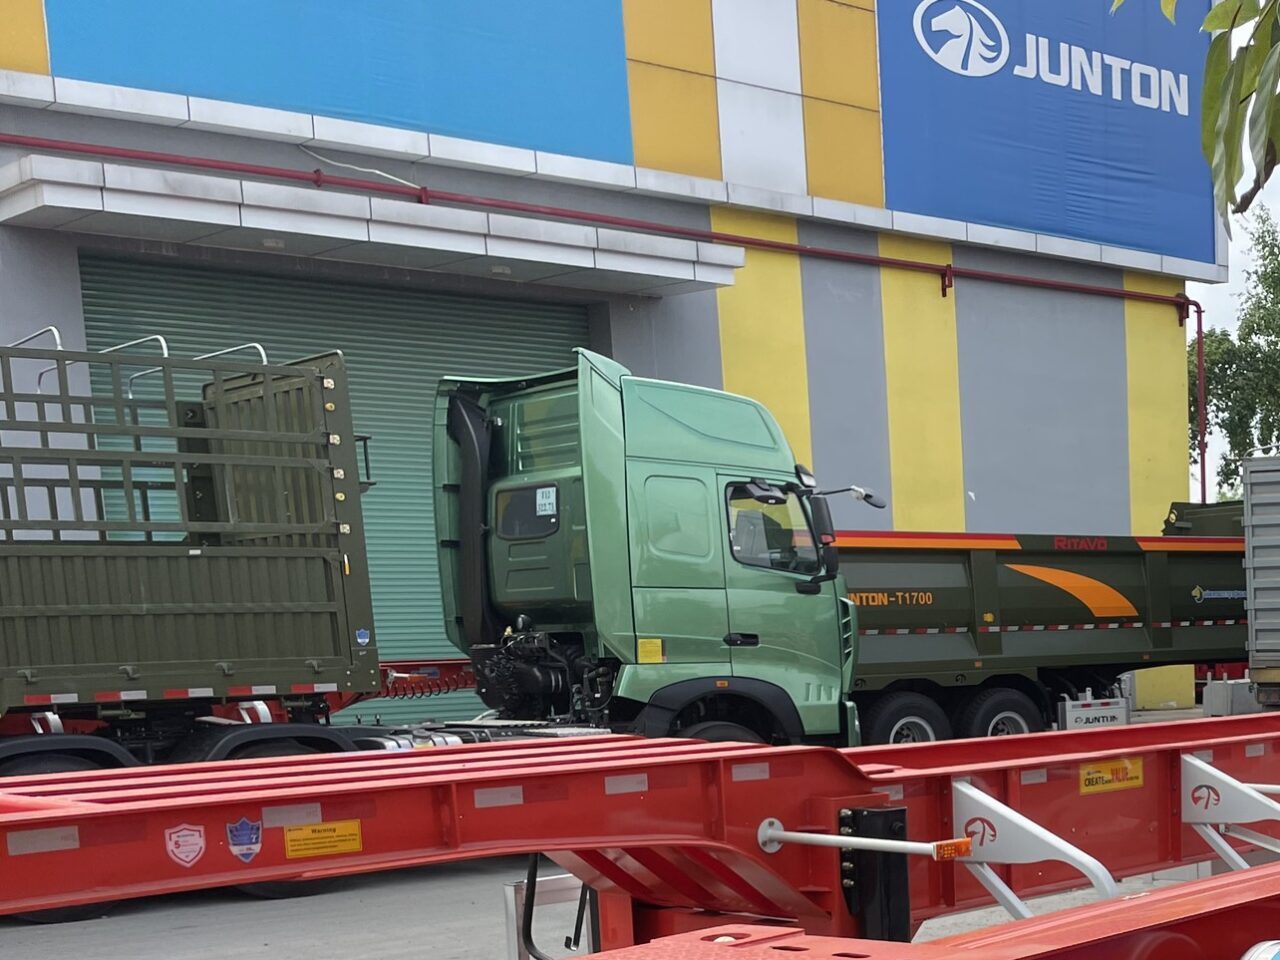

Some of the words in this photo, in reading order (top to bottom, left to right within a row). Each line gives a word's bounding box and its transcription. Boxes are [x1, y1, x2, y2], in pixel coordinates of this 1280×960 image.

[1012, 33, 1189, 116] JUNTON
[848, 592, 933, 606] NTON-T1700
[311, 826, 337, 834] Warning
